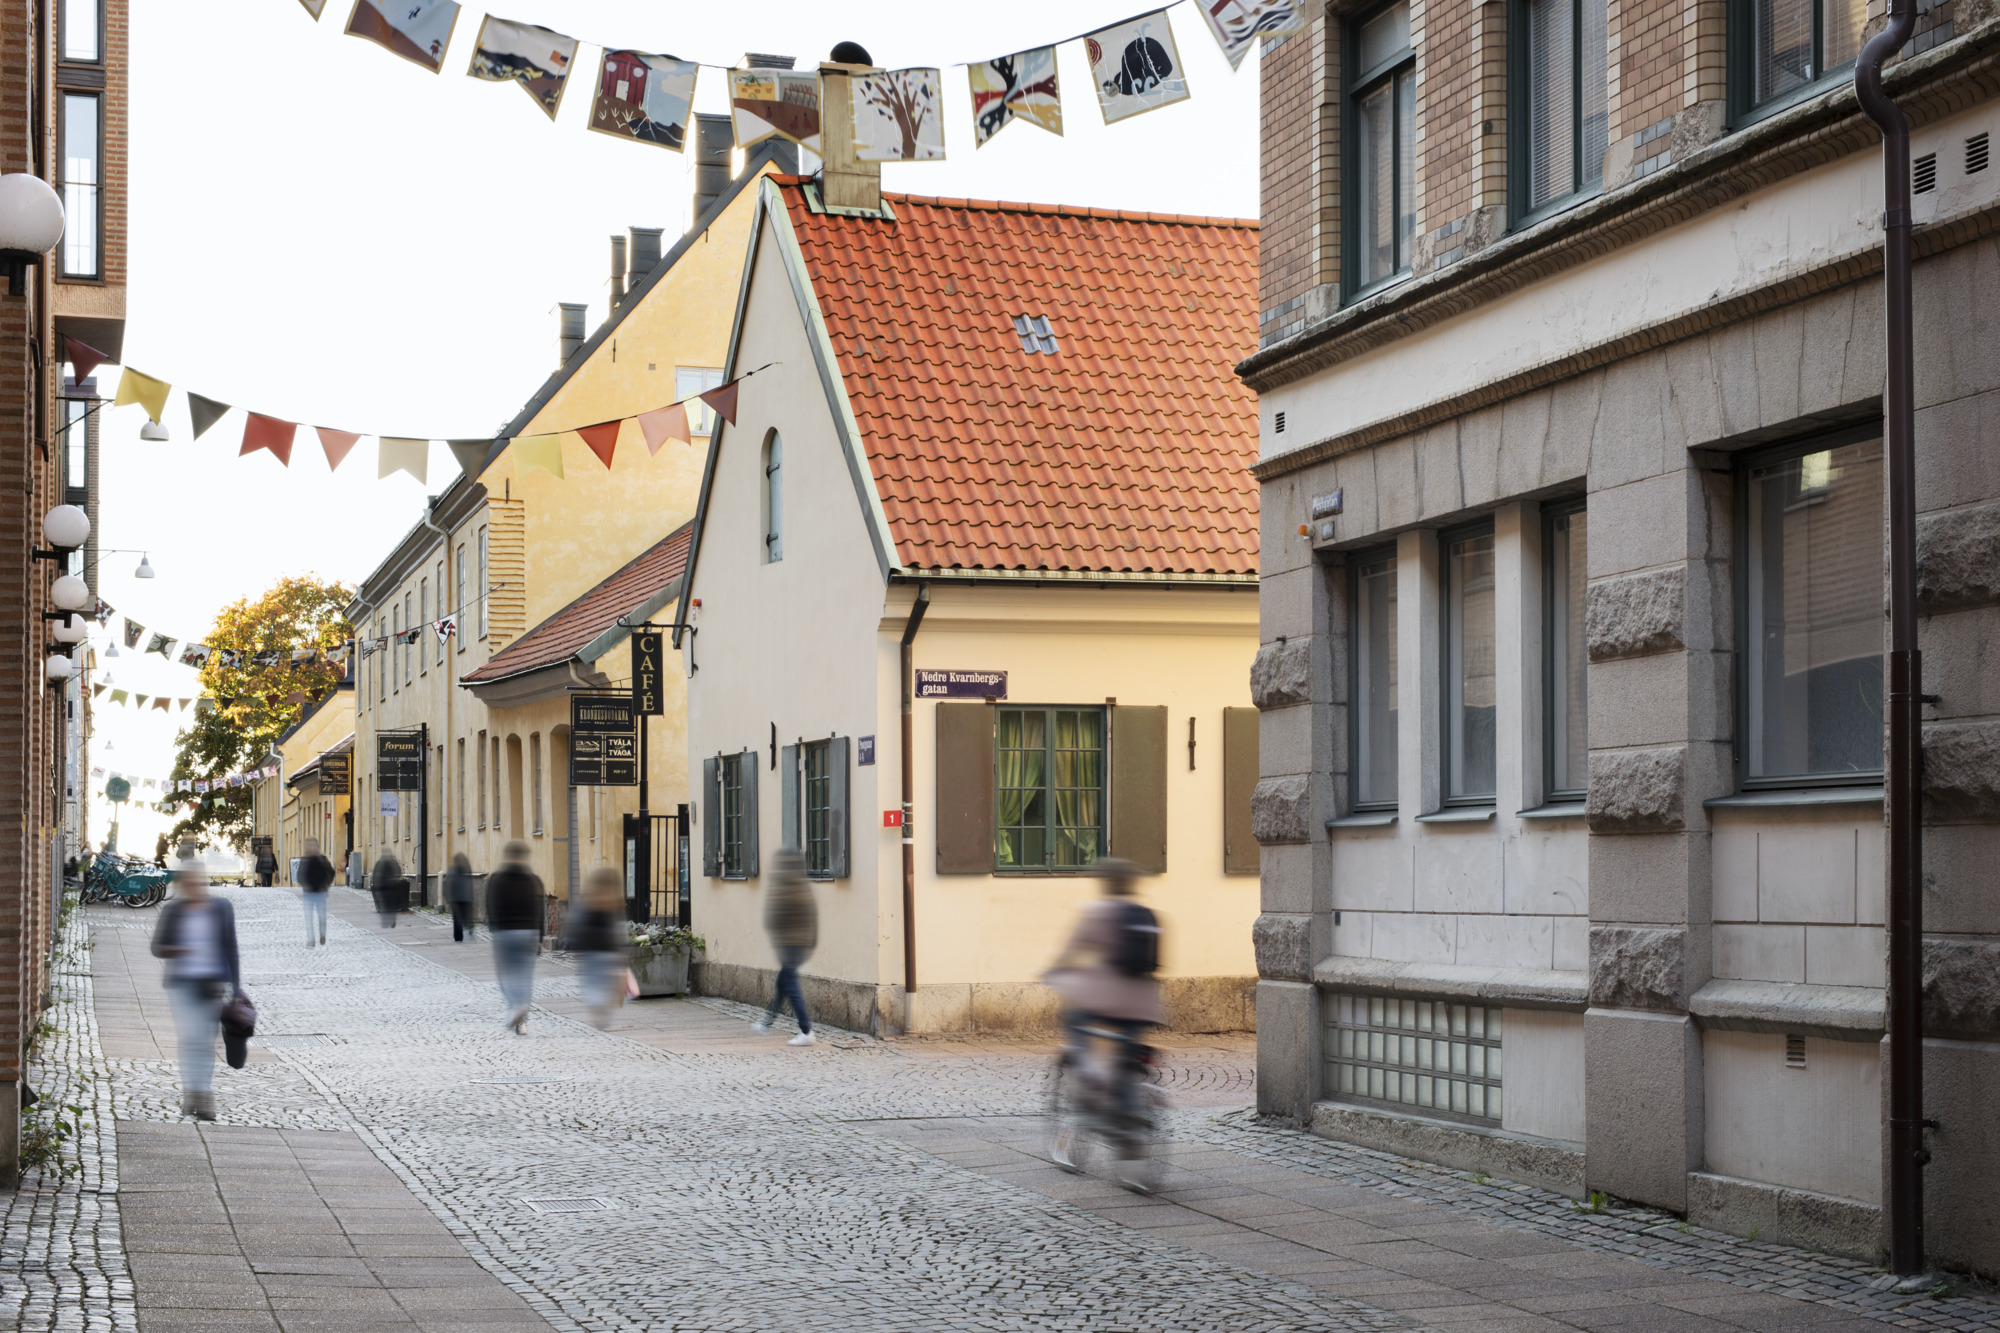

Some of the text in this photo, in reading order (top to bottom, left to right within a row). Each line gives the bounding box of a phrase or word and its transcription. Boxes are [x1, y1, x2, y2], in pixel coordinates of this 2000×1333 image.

[640, 636, 655, 711] CAFÉ
[921, 671, 1002, 685] Nedre Kvarnbergs-
[922, 684, 948, 696] gatan
[382, 741, 415, 752] forum
[608, 738, 632, 747] TVÅLA
[608, 749, 632, 757] TVAGA
[889, 814, 894, 824] 1
